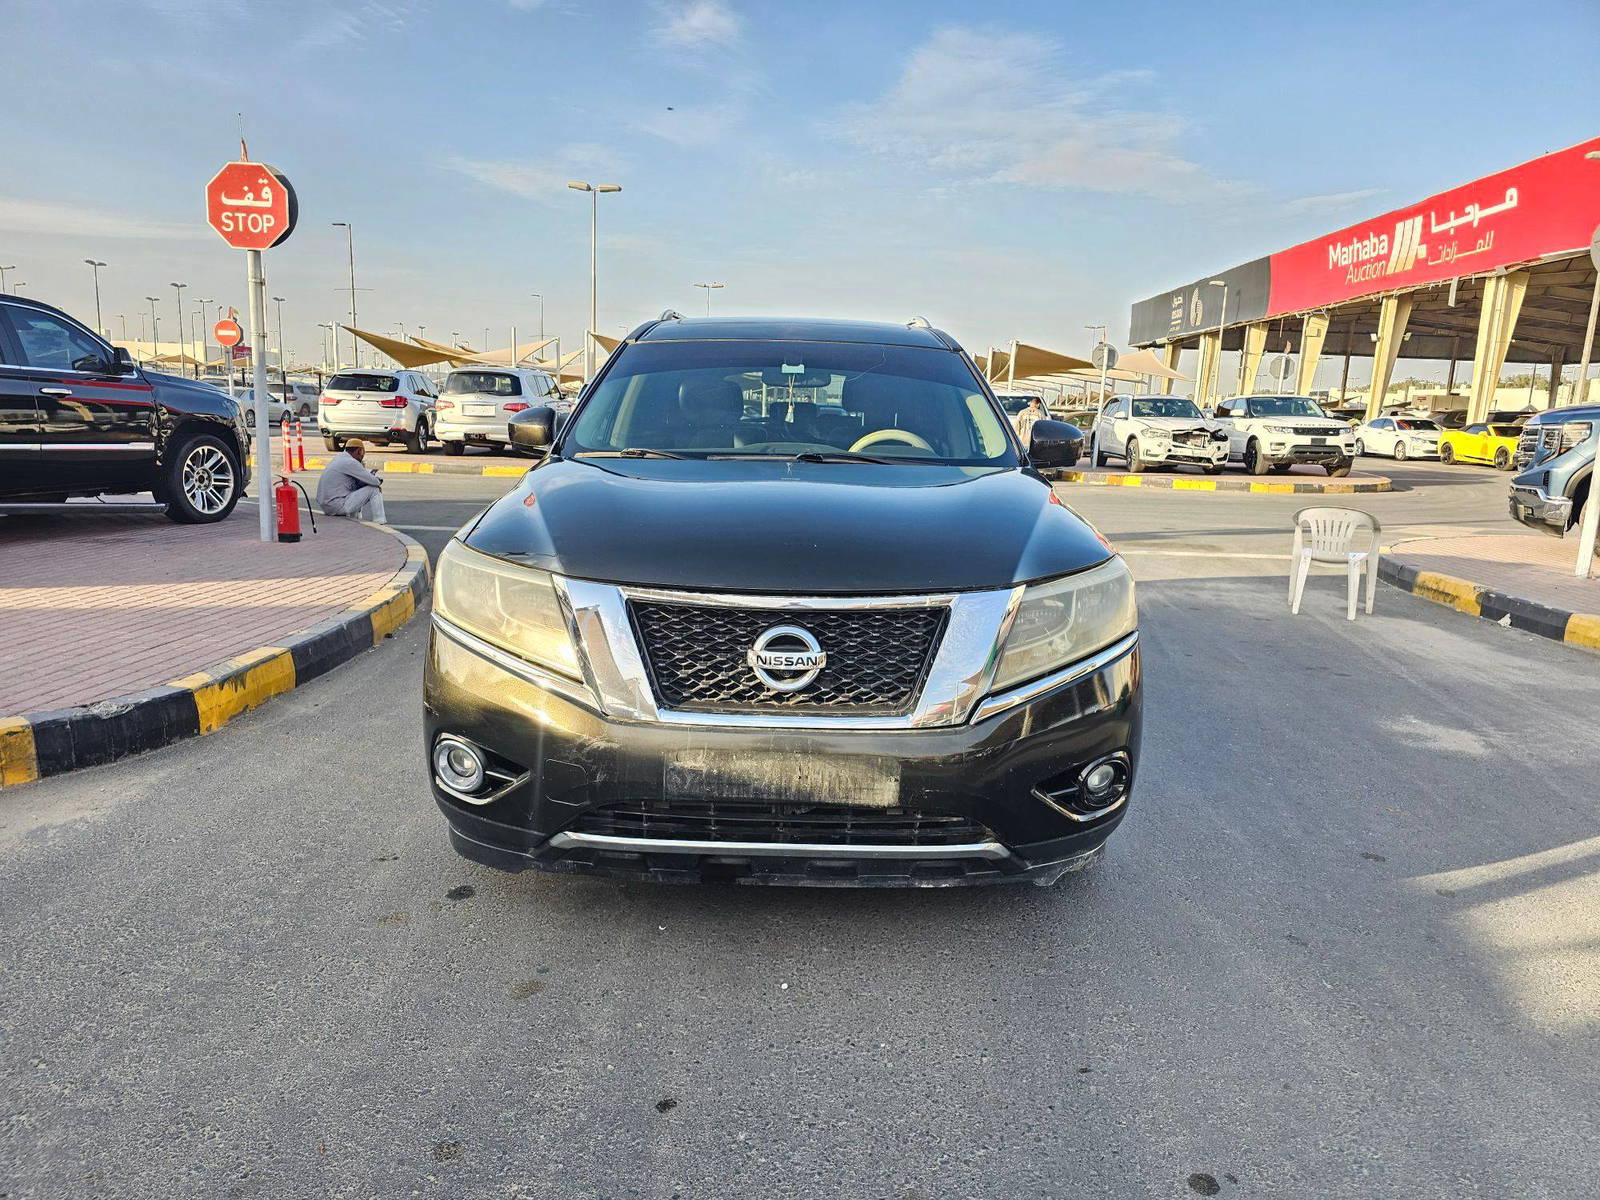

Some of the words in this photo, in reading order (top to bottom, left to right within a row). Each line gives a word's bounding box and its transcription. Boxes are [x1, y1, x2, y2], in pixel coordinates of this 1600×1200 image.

[221, 177, 273, 207] قف
[221, 212, 275, 234] STOP
[1430, 187, 1518, 235] مرحبا
[1328, 232, 1388, 270] Marhaba
[1345, 258, 1387, 285] Auction
[756, 654, 818, 667] NISSAN
